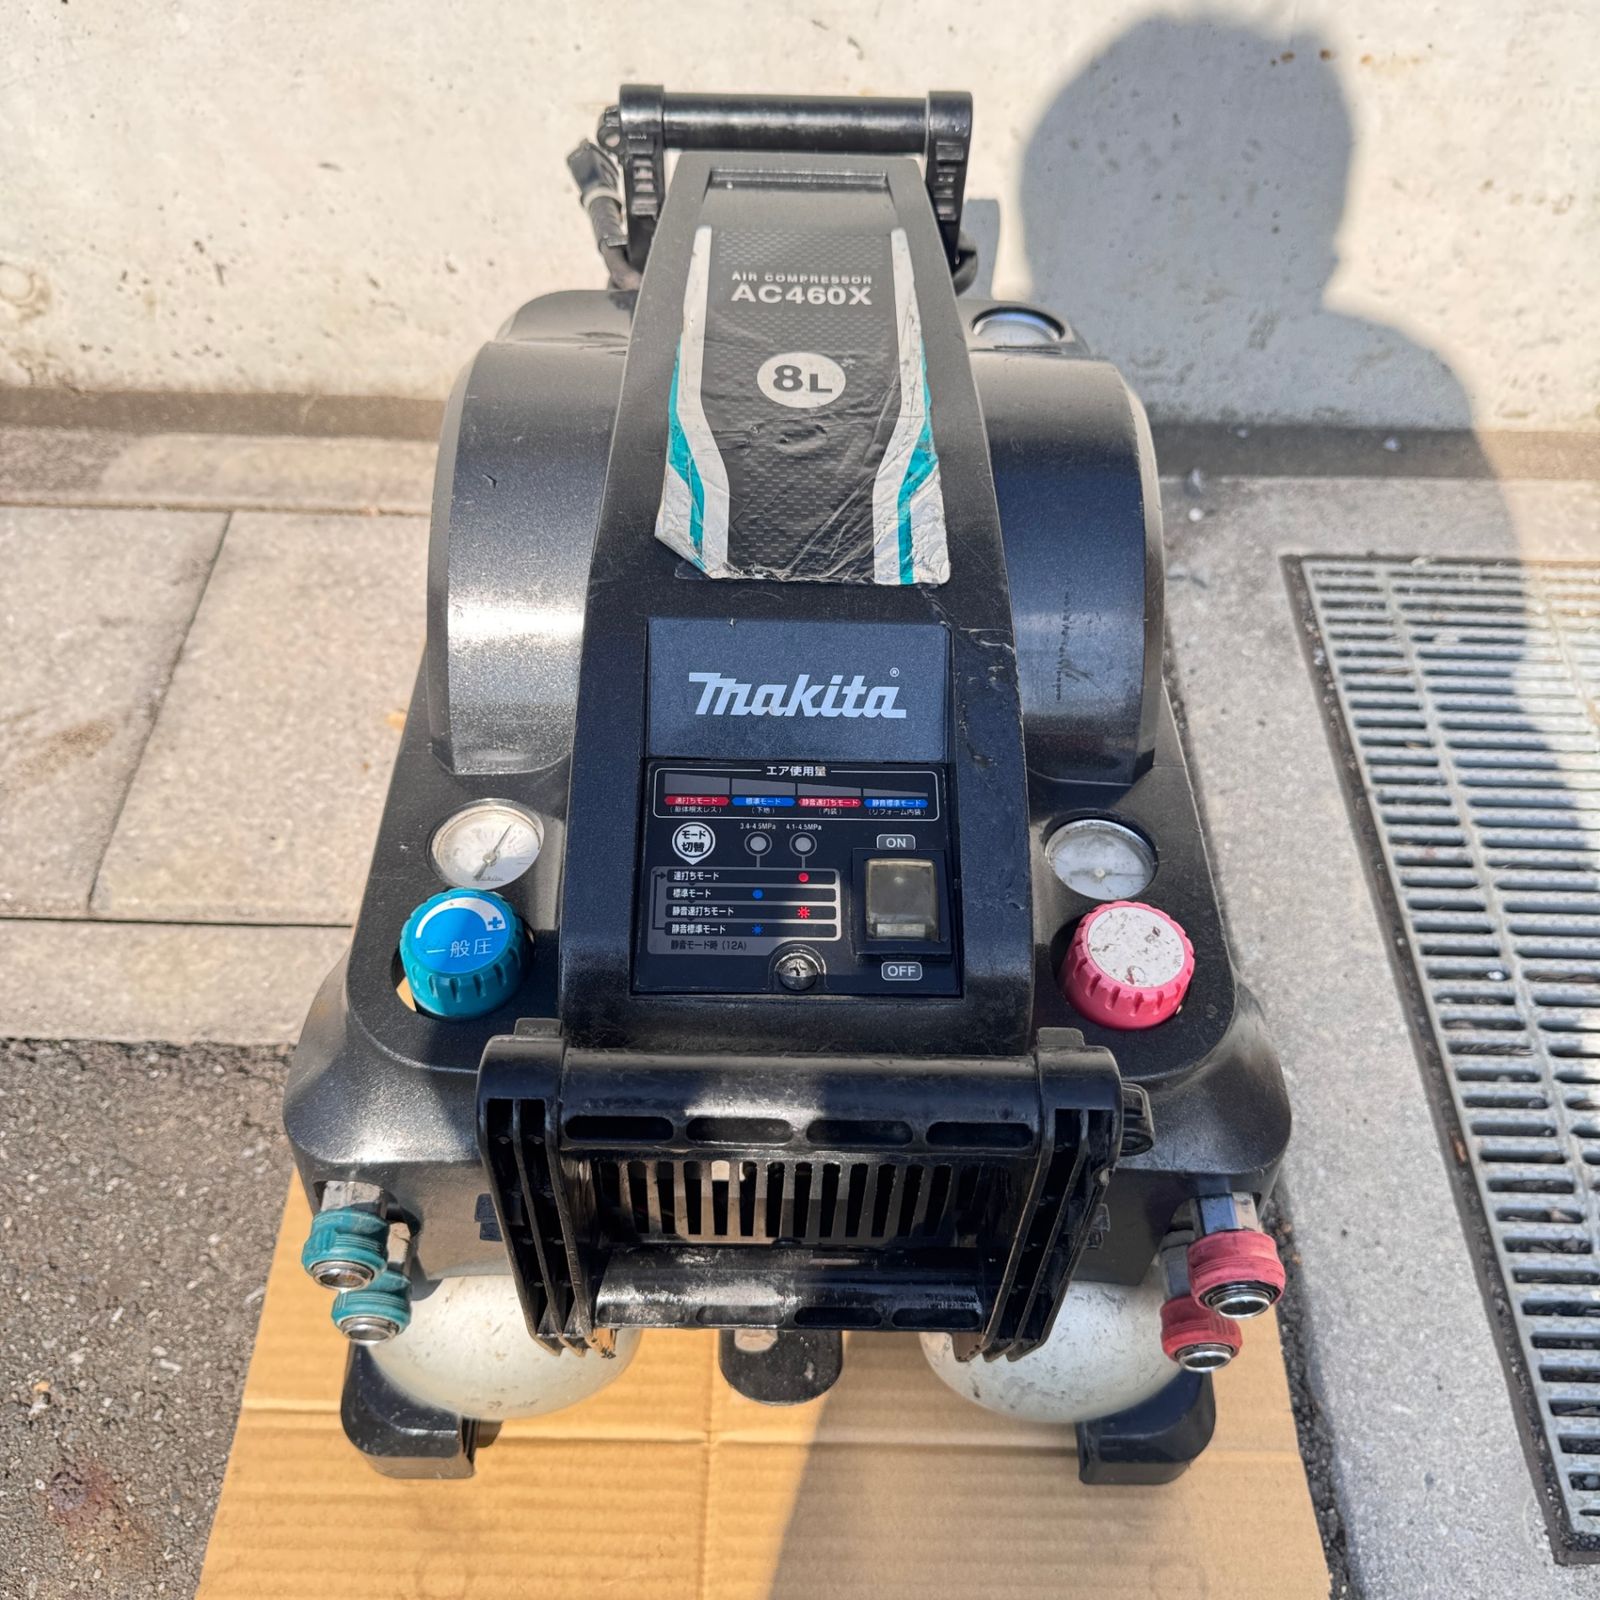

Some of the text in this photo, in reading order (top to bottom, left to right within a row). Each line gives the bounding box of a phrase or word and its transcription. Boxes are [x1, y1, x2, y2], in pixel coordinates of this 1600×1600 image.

[731, 270, 872, 284] AIR COMPRESSOR
[731, 283, 873, 305] AC460X
[772, 364, 833, 394] 8L
[766, 765, 827, 777] エア使用量
[681, 830, 706, 840] モード
[681, 842, 706, 853] 切替
[886, 837, 907, 849] ON
[672, 888, 712, 899] 標準モード
[671, 923, 727, 935] 静音標準モード
[426, 937, 493, 958] 一般圧
[887, 965, 917, 977] OFF
